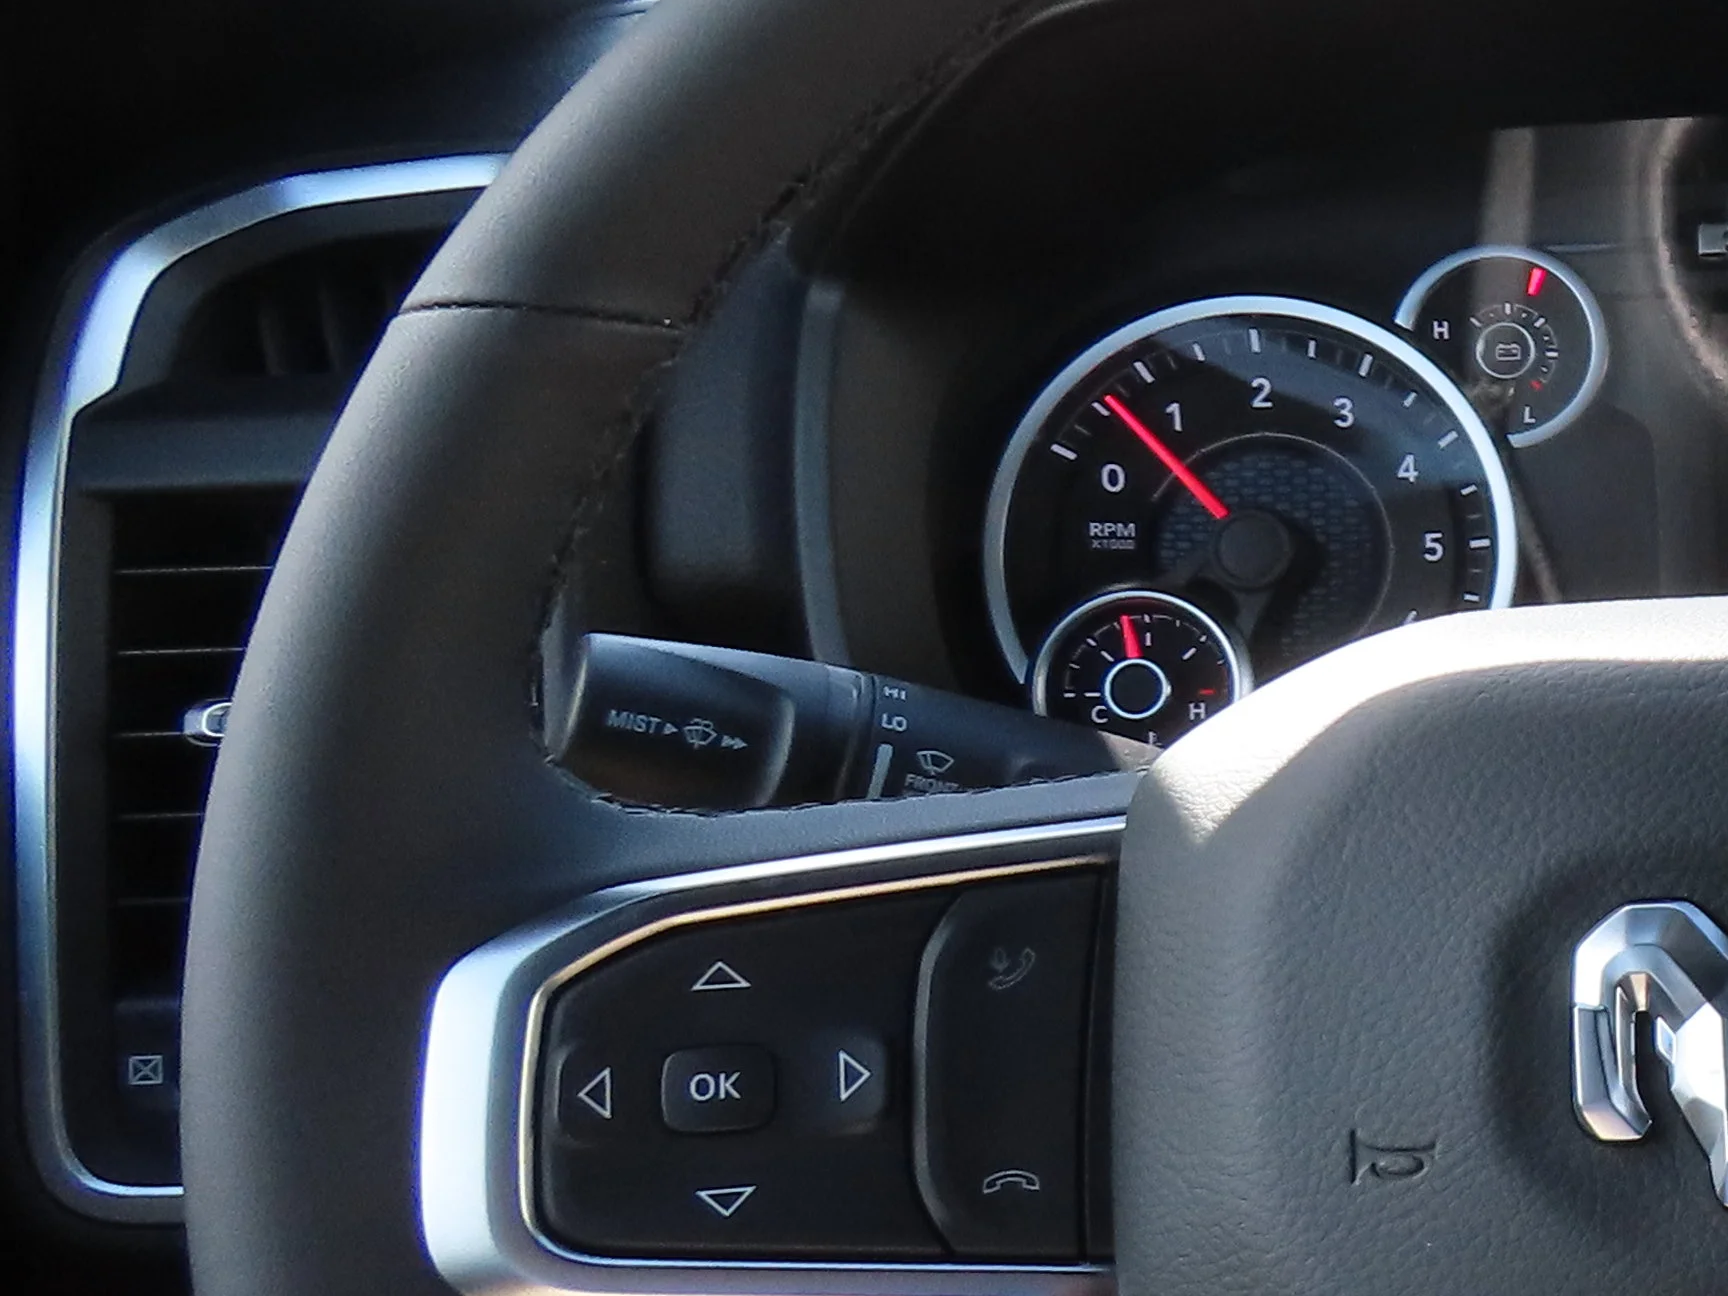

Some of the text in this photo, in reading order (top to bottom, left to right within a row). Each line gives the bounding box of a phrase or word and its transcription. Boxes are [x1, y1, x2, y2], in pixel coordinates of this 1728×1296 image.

[1432, 320, 1450, 340] H
[1251, 377, 1273, 409] 2
[1165, 403, 1183, 431] 1
[1333, 397, 1355, 428] 3
[1523, 406, 1537, 425] L
[1100, 461, 1126, 493] 0
[1397, 454, 1419, 483] 4
[1089, 522, 1136, 537] RPM
[1423, 532, 1444, 561] 5
[606, 707, 664, 736] MIST
[881, 712, 909, 733] LO
[1090, 705, 1108, 725] C
[1189, 700, 1206, 721] H
[689, 1071, 741, 1102] OK
